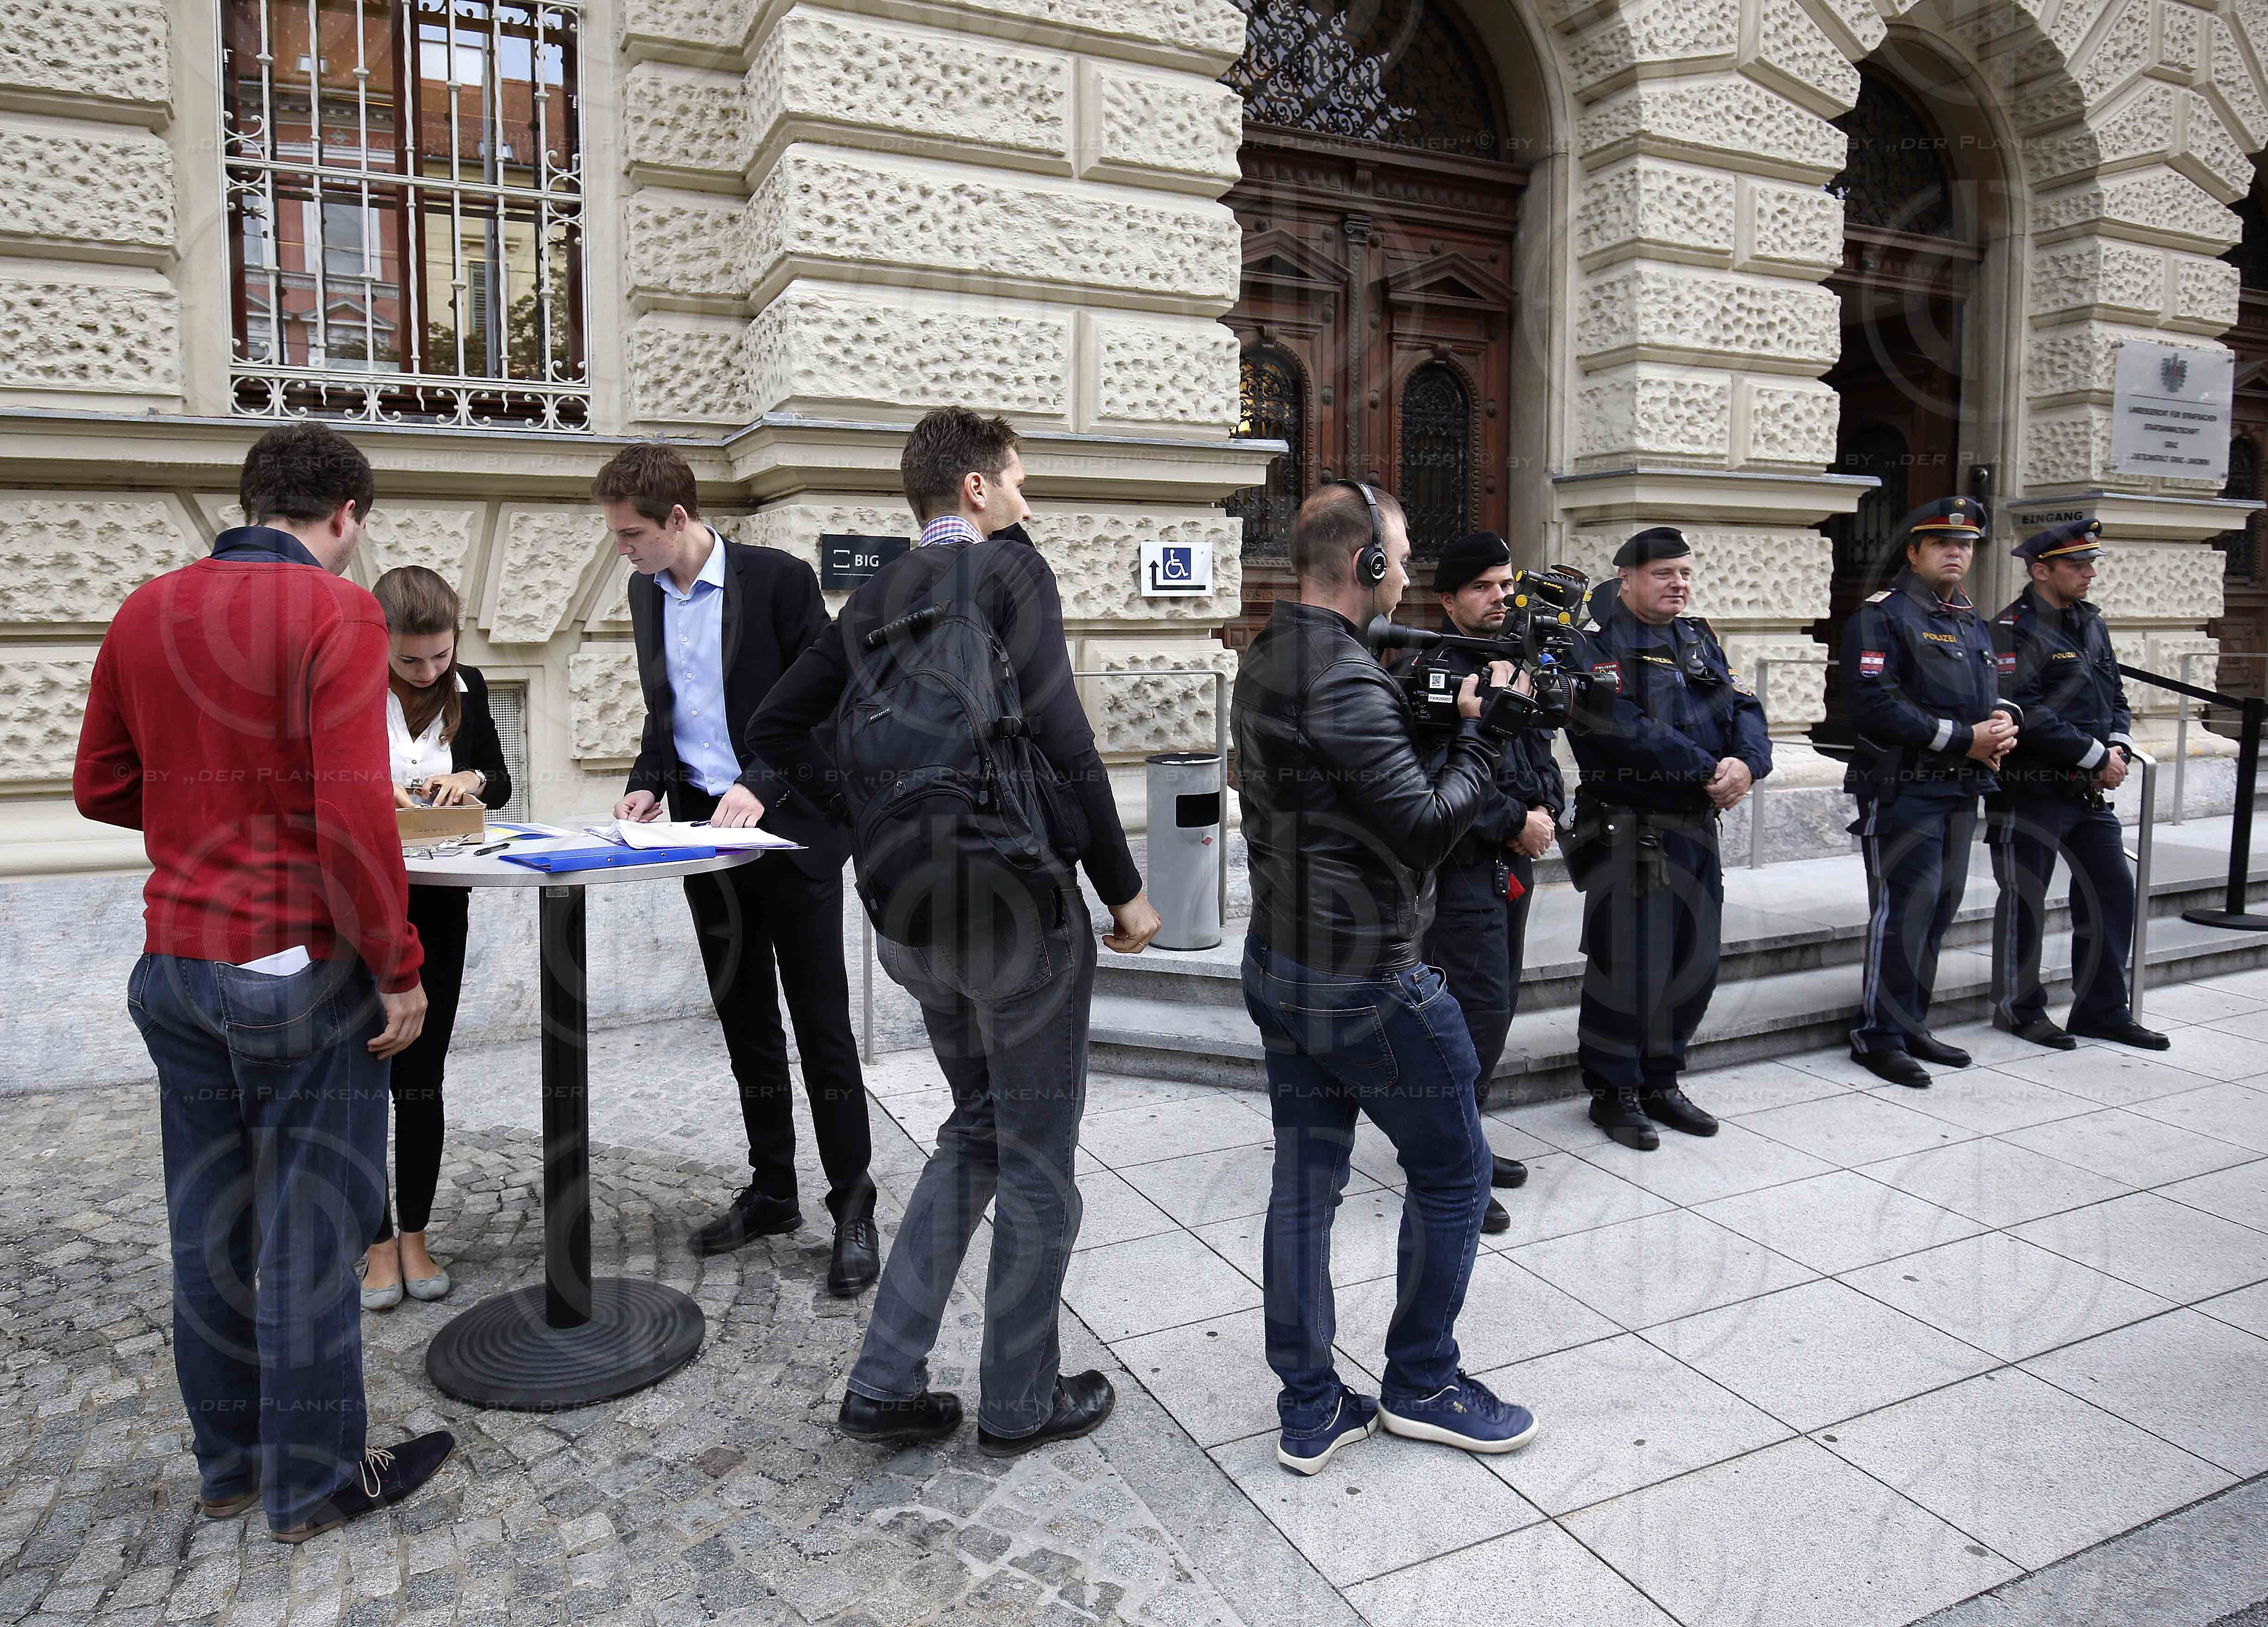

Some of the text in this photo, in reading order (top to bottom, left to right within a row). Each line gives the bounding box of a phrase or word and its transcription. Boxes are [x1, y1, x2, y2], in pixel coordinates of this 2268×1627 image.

[2022, 511, 2083, 524] EINGANG
[855, 554, 879, 567] BIG
[1923, 632, 1957, 643] POLIZEI
[2053, 652, 2075, 660] POLIZEI
